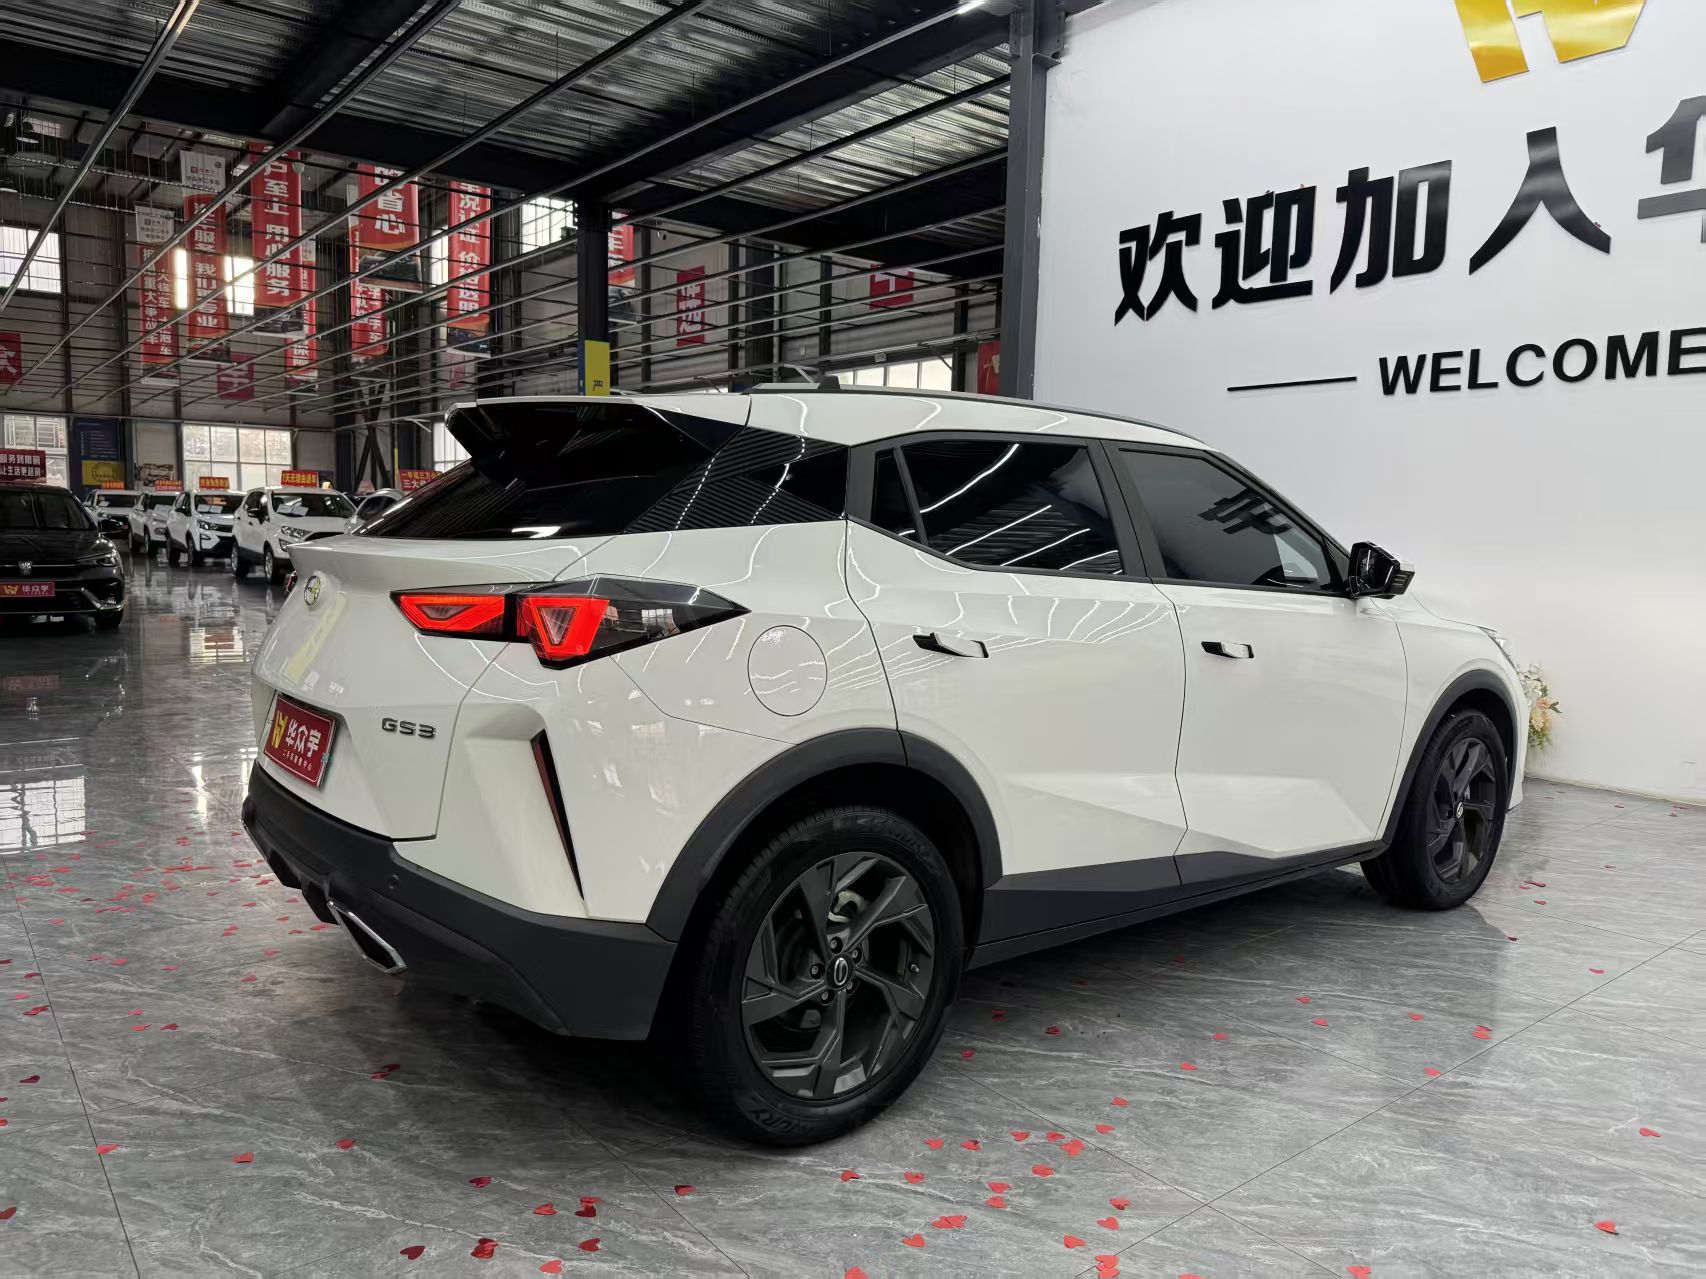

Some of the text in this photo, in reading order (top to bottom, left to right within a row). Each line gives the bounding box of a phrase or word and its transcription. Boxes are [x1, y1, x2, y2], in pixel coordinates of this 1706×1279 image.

[262, 145, 290, 217] 户至上
[1378, 327, 1706, 396] WELCOME
[285, 718, 322, 758] 华众宇
[381, 717, 437, 739] GS3
